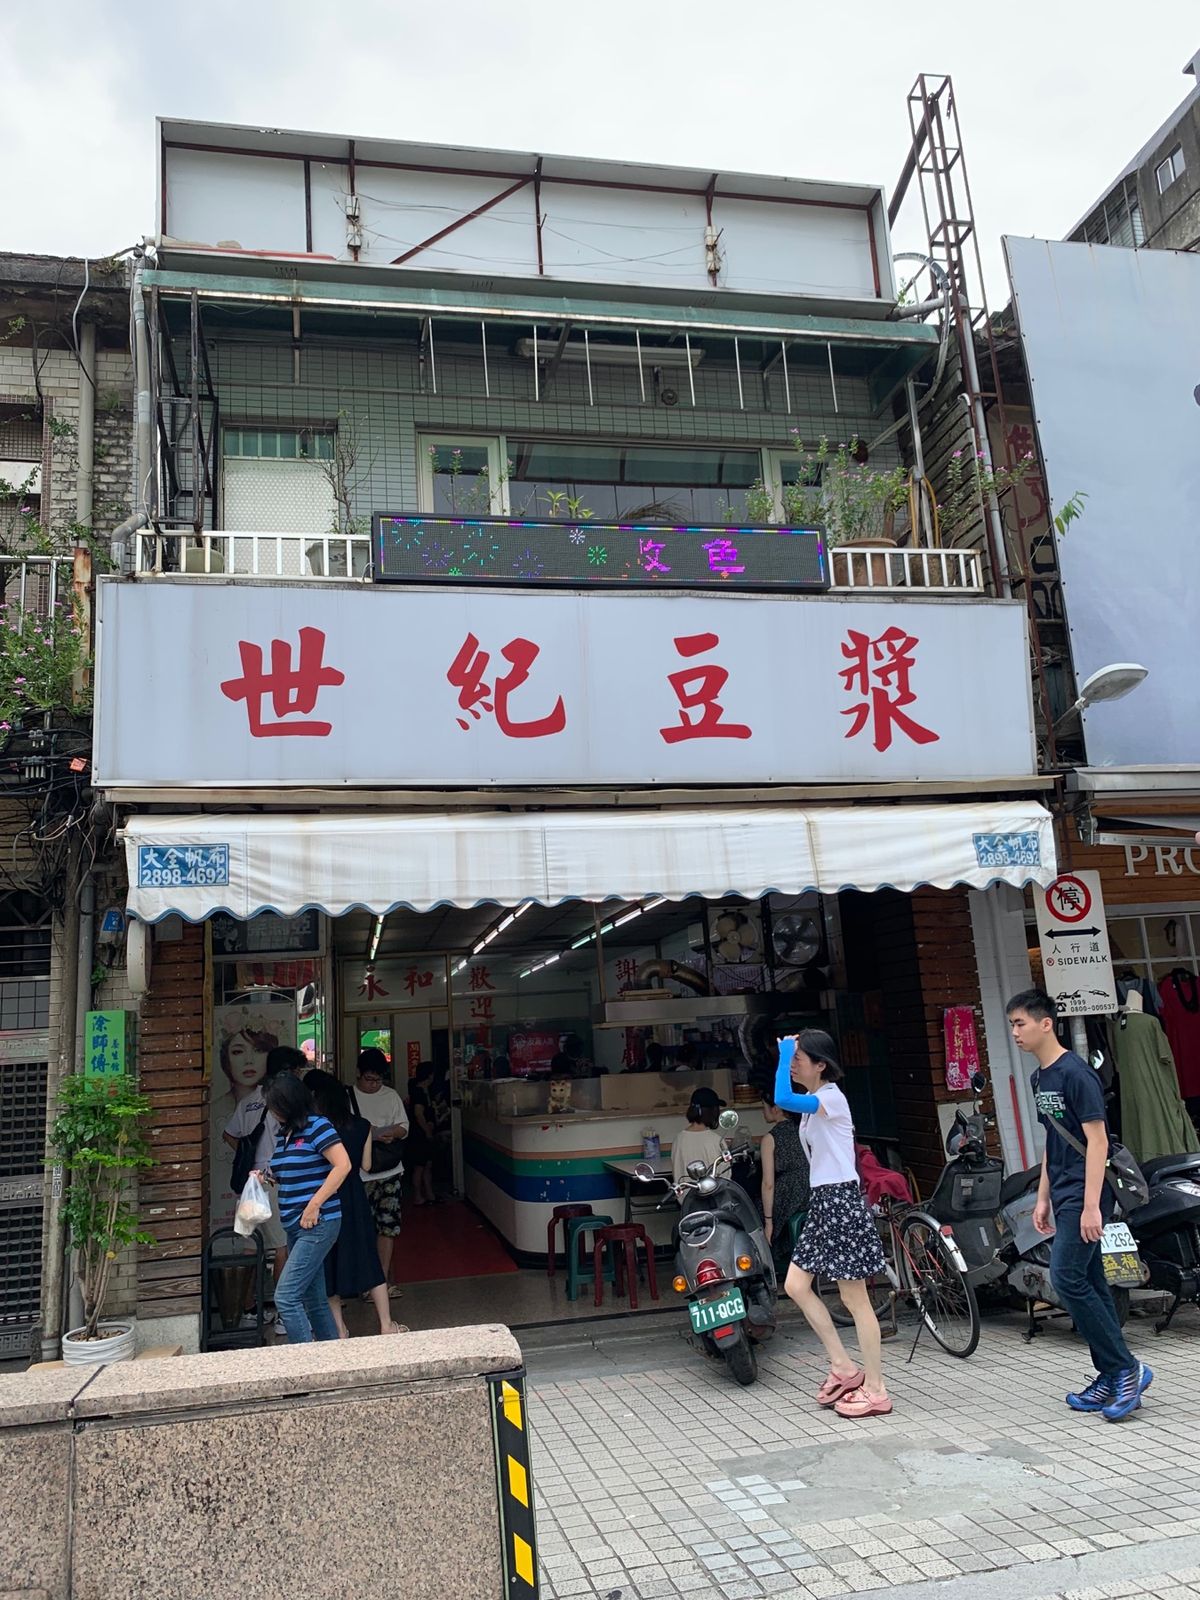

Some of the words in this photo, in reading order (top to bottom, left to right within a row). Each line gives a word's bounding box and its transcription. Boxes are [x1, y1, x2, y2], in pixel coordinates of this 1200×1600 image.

[221, 626, 940, 753] 世紀豆漿
[142, 846, 226, 869] 大全帆布
[142, 868, 226, 886] 2898-4692
[1057, 887, 1080, 911] 停
[1052, 941, 1100, 954] 人行道
[1057, 955, 1108, 967] SIDEWALK
[358, 965, 434, 1002] 永和
[1070, 1003, 1116, 1013] 0800-000537
[692, 1298, 744, 1328] 711-QCG
